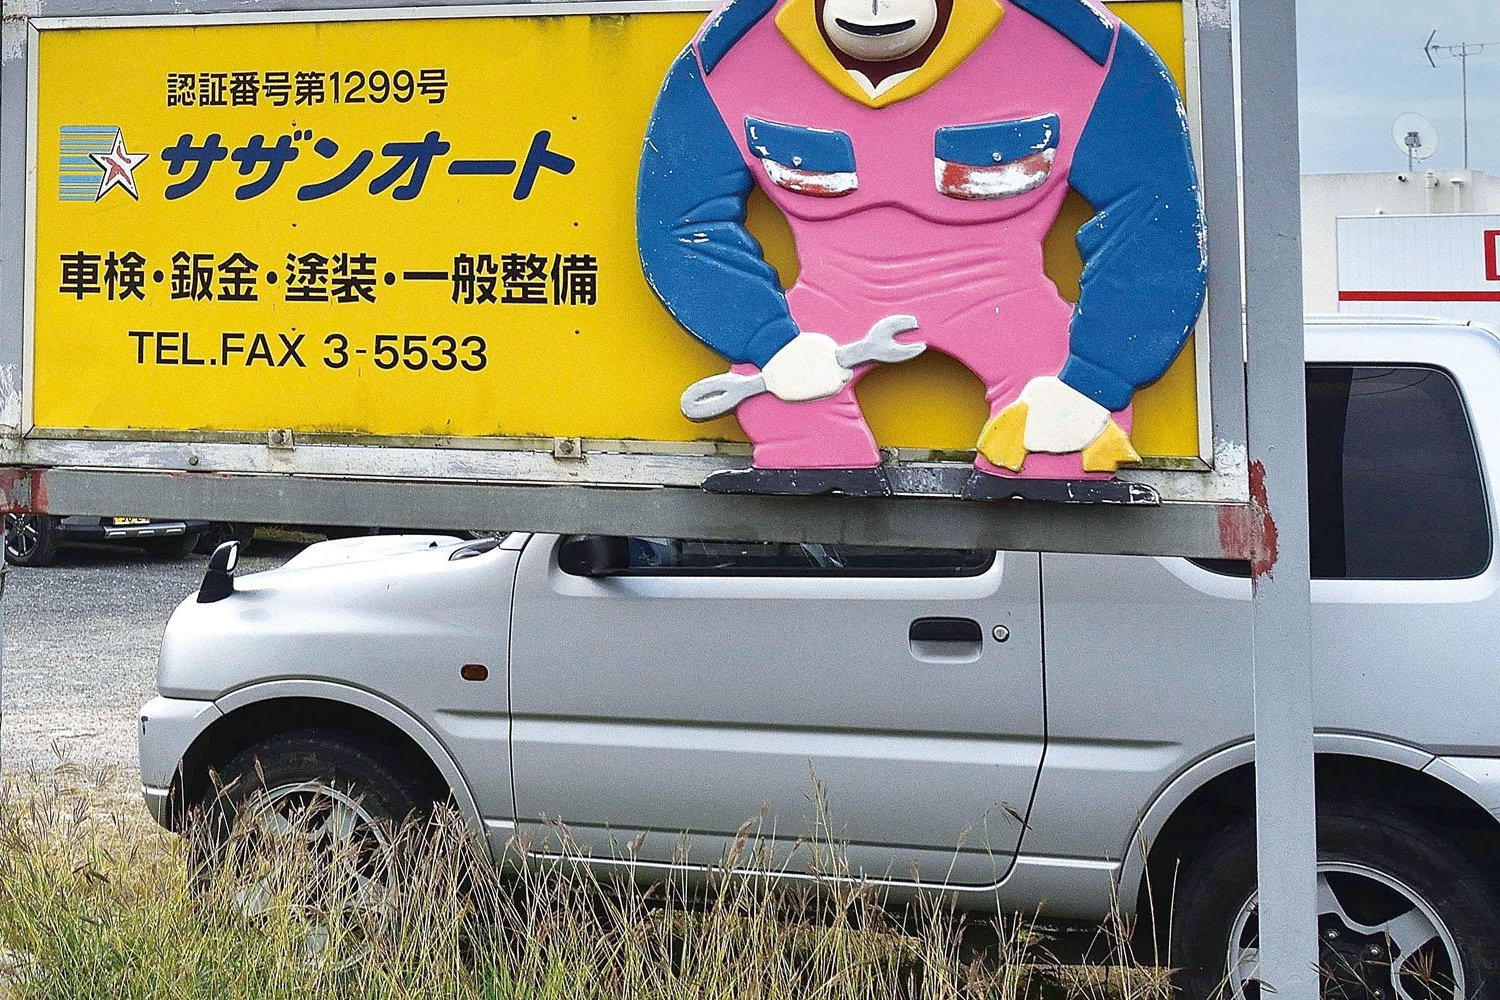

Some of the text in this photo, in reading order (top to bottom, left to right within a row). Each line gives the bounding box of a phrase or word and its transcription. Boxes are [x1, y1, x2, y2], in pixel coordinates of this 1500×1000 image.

[167, 69, 449, 107] 認証番号第1299号
[161, 130, 576, 201] サザンオート
[59, 251, 598, 306] 車検・鈑金・塗装・一般整備
[129, 330, 488, 372] TEL.FAX 3-5533
